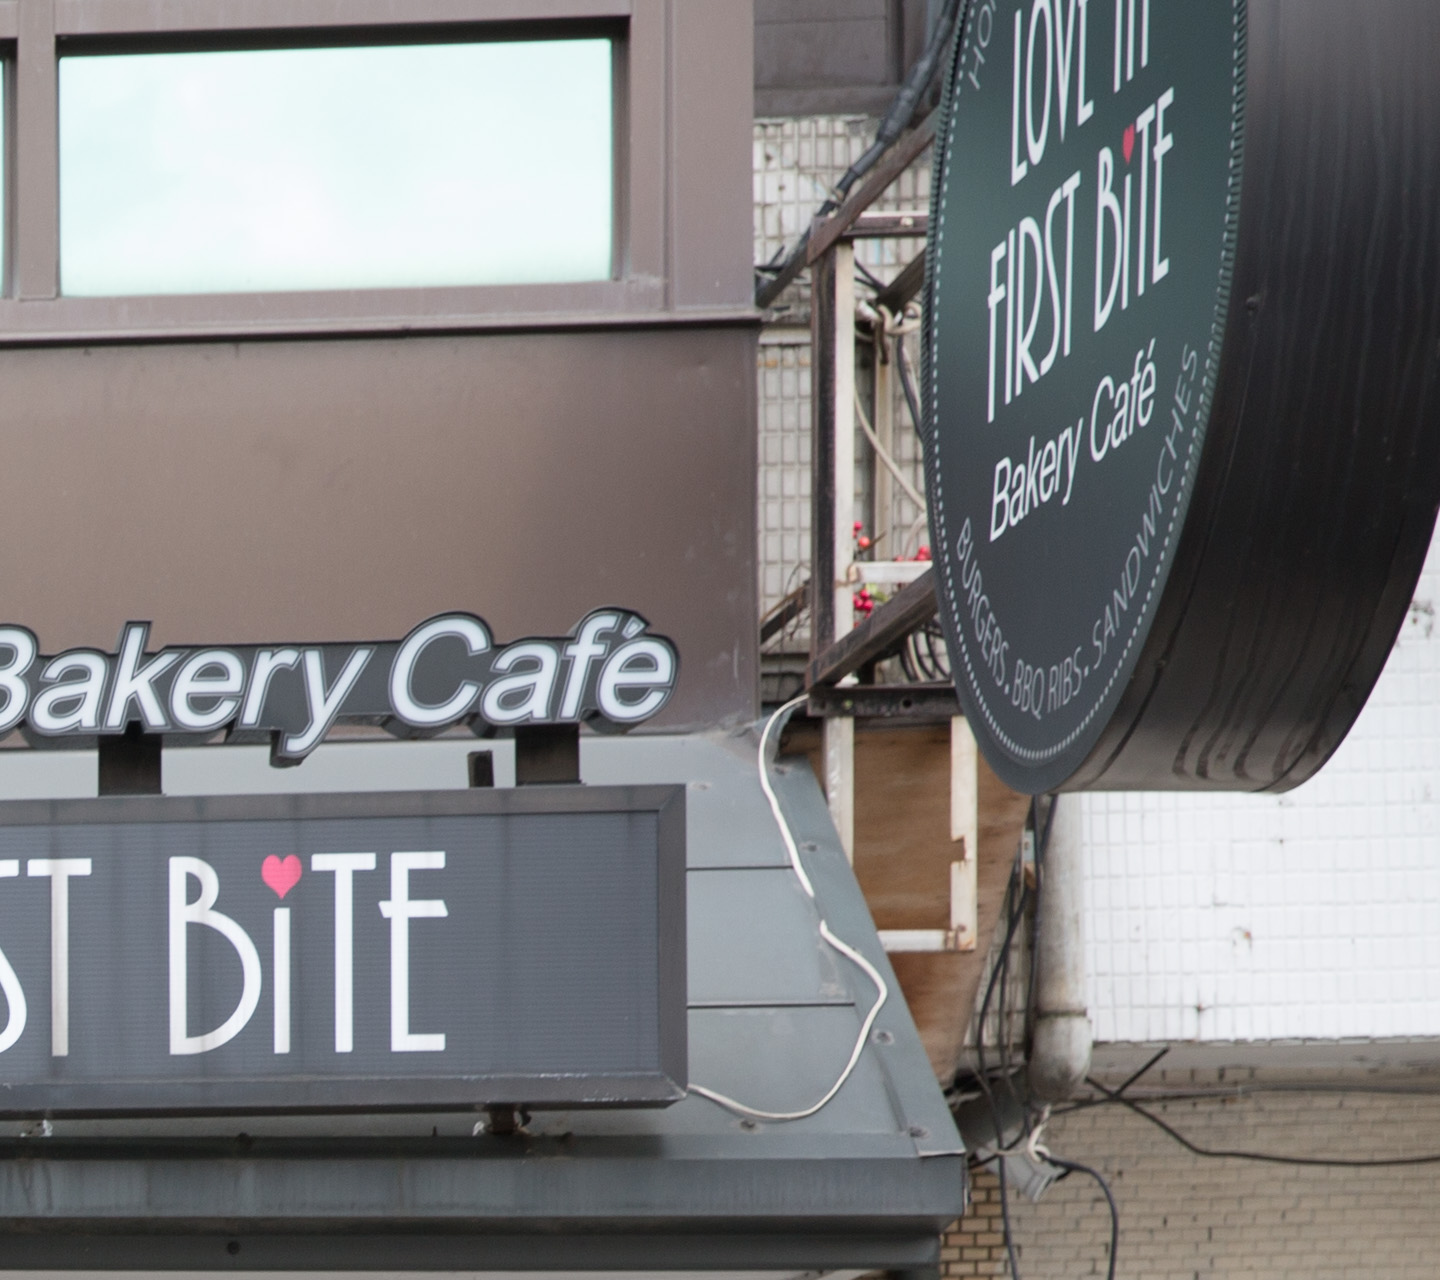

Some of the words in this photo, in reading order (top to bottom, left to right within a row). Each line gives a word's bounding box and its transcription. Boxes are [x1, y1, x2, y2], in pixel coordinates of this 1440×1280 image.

[1011, 0, 1094, 186] LOVE
[988, 172, 1080, 423] FIRST
[989, 417, 1083, 543] Bakery
[1090, 338, 1156, 462] Café
[1012, 658, 1044, 721] BBQ
[1046, 645, 1083, 714] RIBS
[1091, 343, 1198, 671] SANDWICHES
[391, 614, 677, 730] Café
